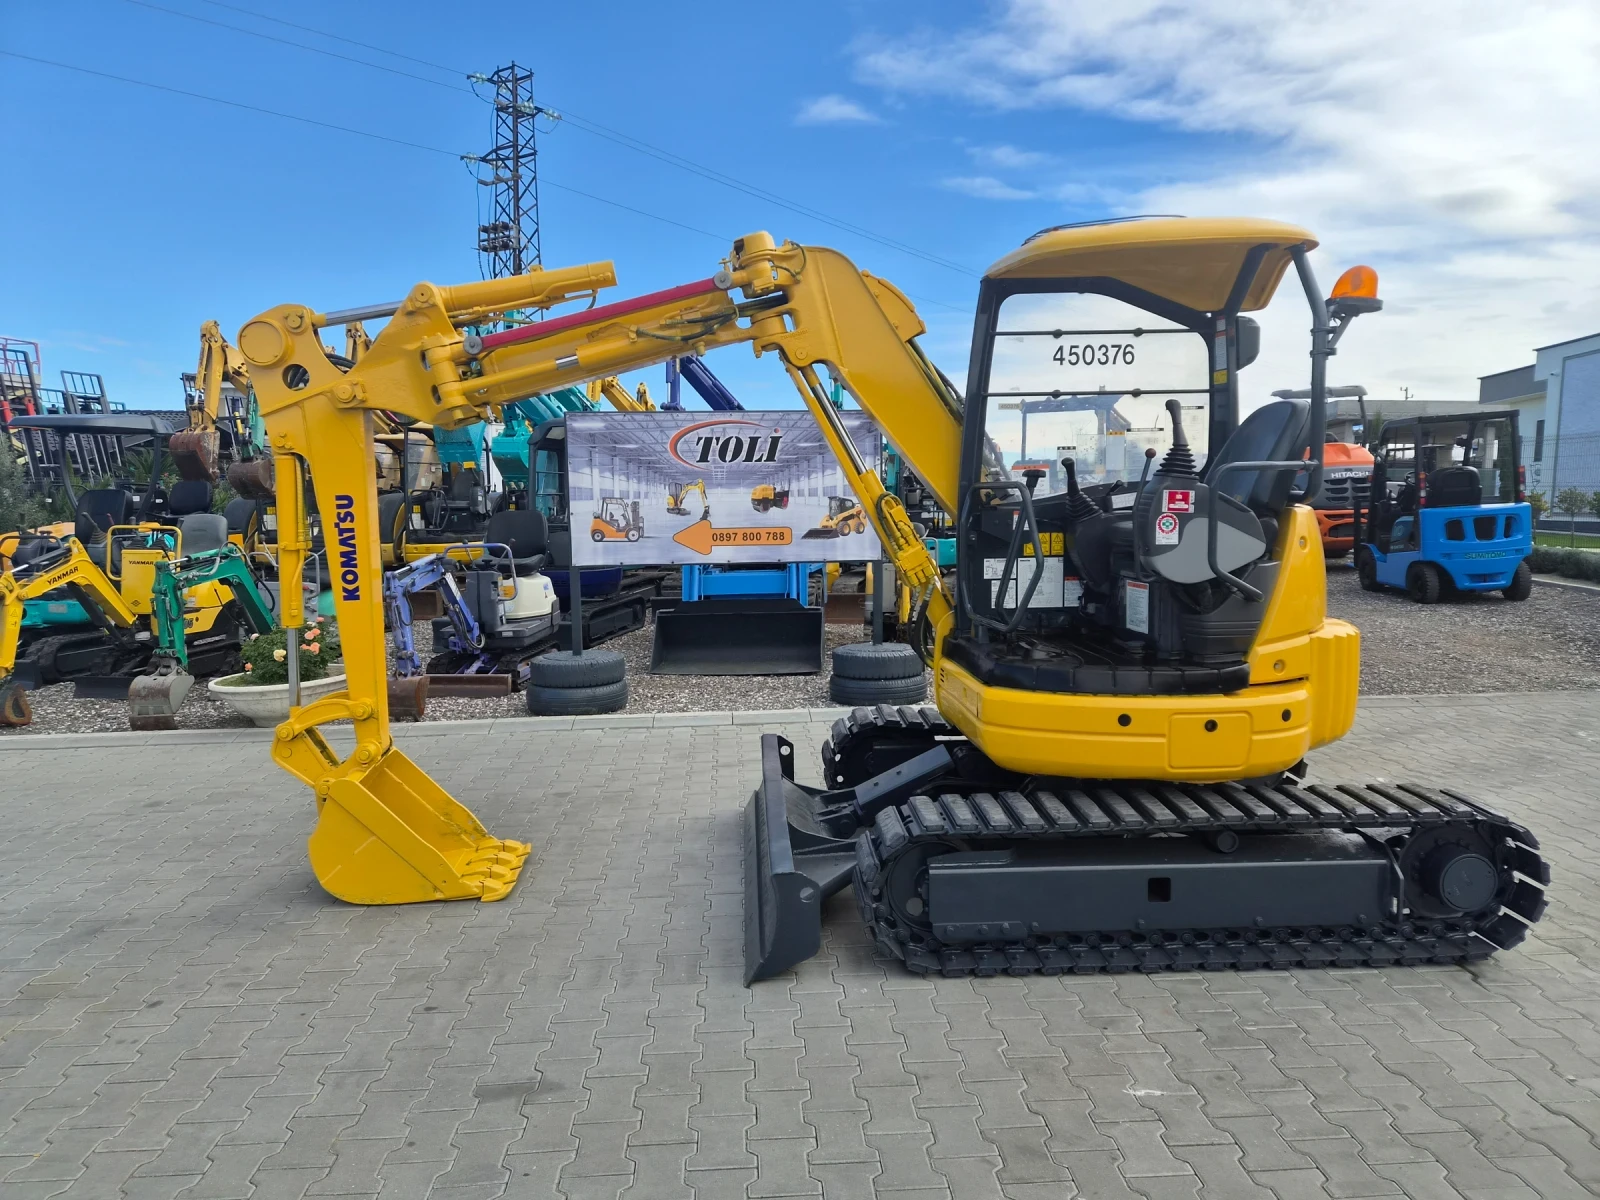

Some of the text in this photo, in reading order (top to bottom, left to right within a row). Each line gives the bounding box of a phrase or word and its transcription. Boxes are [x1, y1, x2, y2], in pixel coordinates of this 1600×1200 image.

[1053, 344, 1135, 366] 450376
[712, 531, 785, 542] 0897 800 788
[334, 494, 361, 601] KOMATSU
[46, 565, 79, 586] YANMAR
